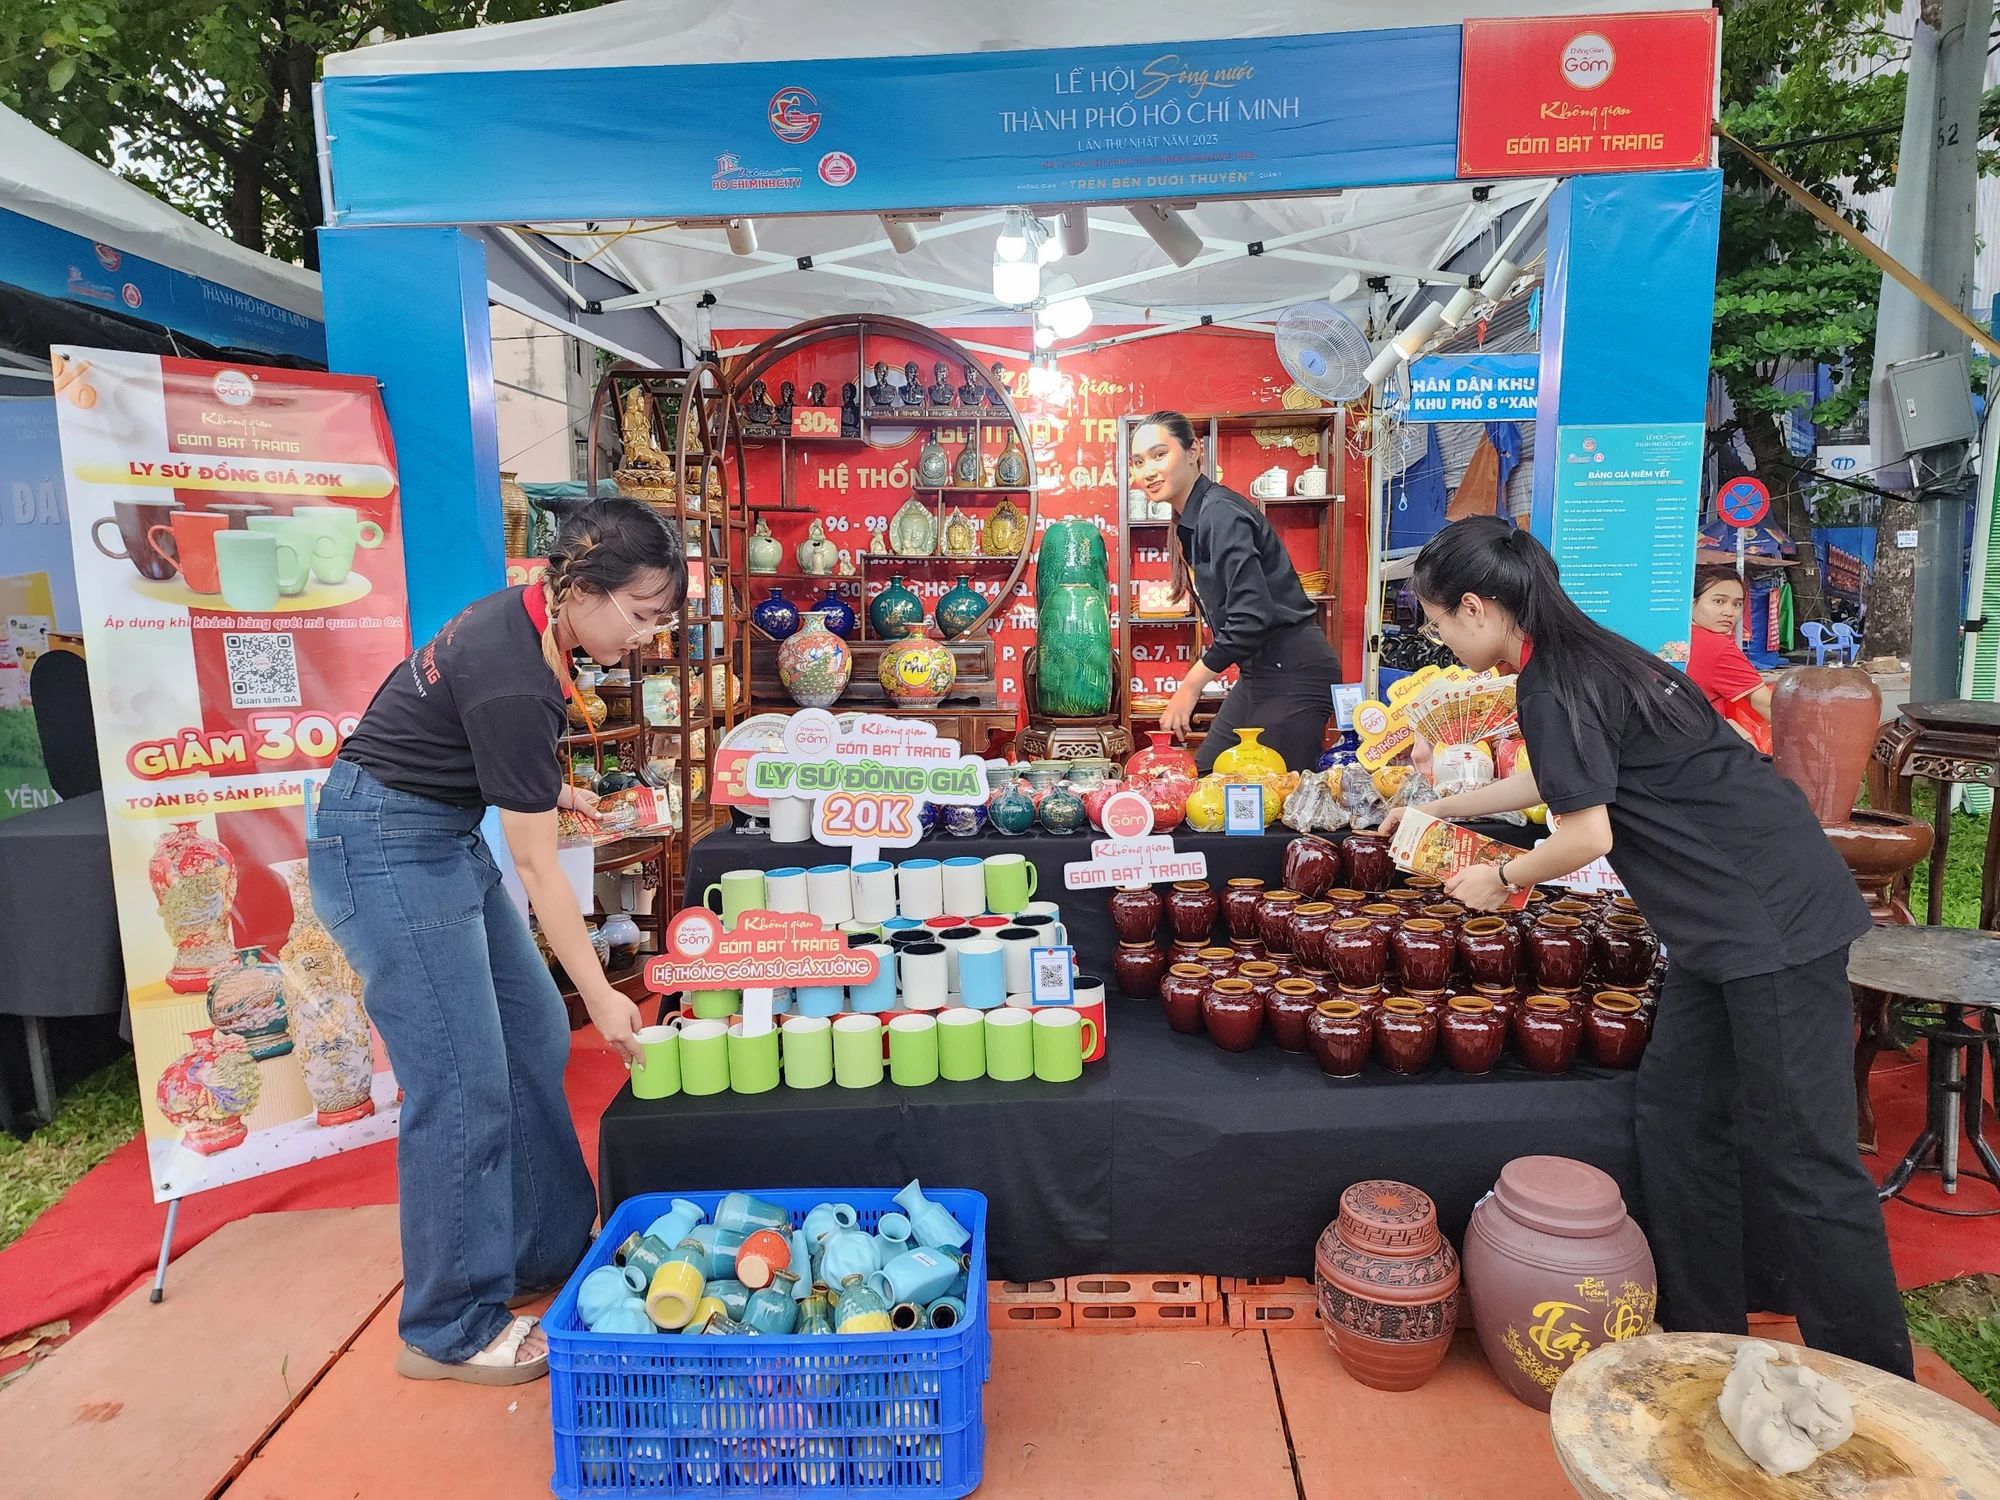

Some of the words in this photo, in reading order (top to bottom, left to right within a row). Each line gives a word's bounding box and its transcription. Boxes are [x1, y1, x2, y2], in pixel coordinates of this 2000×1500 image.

[1564, 55, 1608, 72] Gốm
[1054, 66, 1084, 94] LỄ
[1090, 66, 1134, 96] HỘI
[1134, 54, 1210, 99] Sông
[998, 106, 1076, 133] THÀNH
[1086, 99, 1136, 129] PHỐ
[1142, 96, 1181, 126] HỒ
[1186, 96, 1230, 122] CHÍ
[1238, 96, 1300, 121] MINH
[1540, 101, 1596, 131] Không
[1600, 106, 1632, 131] gian
[1192, 134, 1218, 146] 2023
[1506, 132, 1549, 154] GỐM
[1556, 134, 1594, 153] BÁT
[1600, 132, 1664, 151] TRÀNG
[712, 179, 728, 190] HO
[730, 179, 748, 190] CHI
[748, 178, 776, 190] MINH
[776, 177, 802, 188] CITY
[1412, 377, 1450, 392] HÂN
[1456, 376, 1492, 392] DÂN
[1497, 377, 1536, 391] KHU
[1414, 398, 1446, 410] KHU
[1452, 394, 1482, 410] PHỐ
[1486, 398, 1498, 410] 8
[202, 412, 248, 436] Không
[249, 419, 272, 436] gian
[794, 410, 839, 434] -30%
[176, 432, 212, 447] GỐM
[129, 461, 155, 478] LY
[160, 462, 192, 478] SỨ
[198, 461, 260, 483] ĐỒNG
[264, 468, 298, 485] GIÁ
[304, 473, 344, 488] 20K
[818, 462, 849, 494] HỆ
[824, 516, 849, 532] 96
[864, 516, 888, 532] 98
[1014, 582, 1032, 595] Q.
[104, 616, 125, 630] Áp
[130, 616, 165, 630] dụng
[169, 616, 190, 628] khi
[193, 616, 234, 629] khách
[236, 616, 270, 630] hàng
[272, 616, 303, 630] quét
[304, 618, 324, 628] mã
[326, 618, 356, 630] quan
[359, 616, 382, 628] tâm
[384, 616, 404, 629] OA
[1002, 646, 1017, 662] P.
[1132, 646, 1170, 664] Q.7,
[1002, 678, 1017, 693] P.
[235, 695, 262, 706] Quan
[263, 695, 281, 704] tâm
[282, 695, 298, 704] OA
[796, 732, 828, 744] Gốm
[862, 722, 902, 744] Không
[905, 728, 928, 746] gian
[1376, 730, 1411, 754] THỐNG
[132, 731, 248, 777] GIẢM
[836, 740, 868, 755] GỐM
[872, 743, 900, 756] BÁT
[906, 742, 951, 758] TRÀNG
[758, 762, 794, 788] LY
[800, 760, 838, 788] SỨ
[842, 760, 927, 791] ĐỒNG
[930, 764, 979, 794] GIÁ
[126, 793, 180, 810] TOÀN
[185, 788, 208, 806] BỘ
[213, 783, 249, 802] SẢN
[254, 778, 301, 798] PHẨM
[826, 797, 909, 834] 20K
[1094, 842, 1144, 864] Không
[1146, 844, 1172, 864] gian
[1070, 867, 1106, 884] GỐM
[1112, 867, 1142, 882] BÁT
[1149, 862, 1202, 878] TRÀNG
[744, 916, 788, 939] Không
[791, 920, 814, 939] gian
[678, 932, 710, 946] Gốm
[718, 938, 752, 954] GỐM
[756, 940, 786, 953] BÁT
[791, 938, 840, 952] TRÀNG
[654, 964, 674, 984] HỆ
[674, 962, 724, 981] THỐNG
[726, 960, 764, 980] GỐM
[766, 958, 785, 977] SỨ
[787, 958, 814, 977] GIÁ
[815, 957, 870, 976] XƯỞNG
